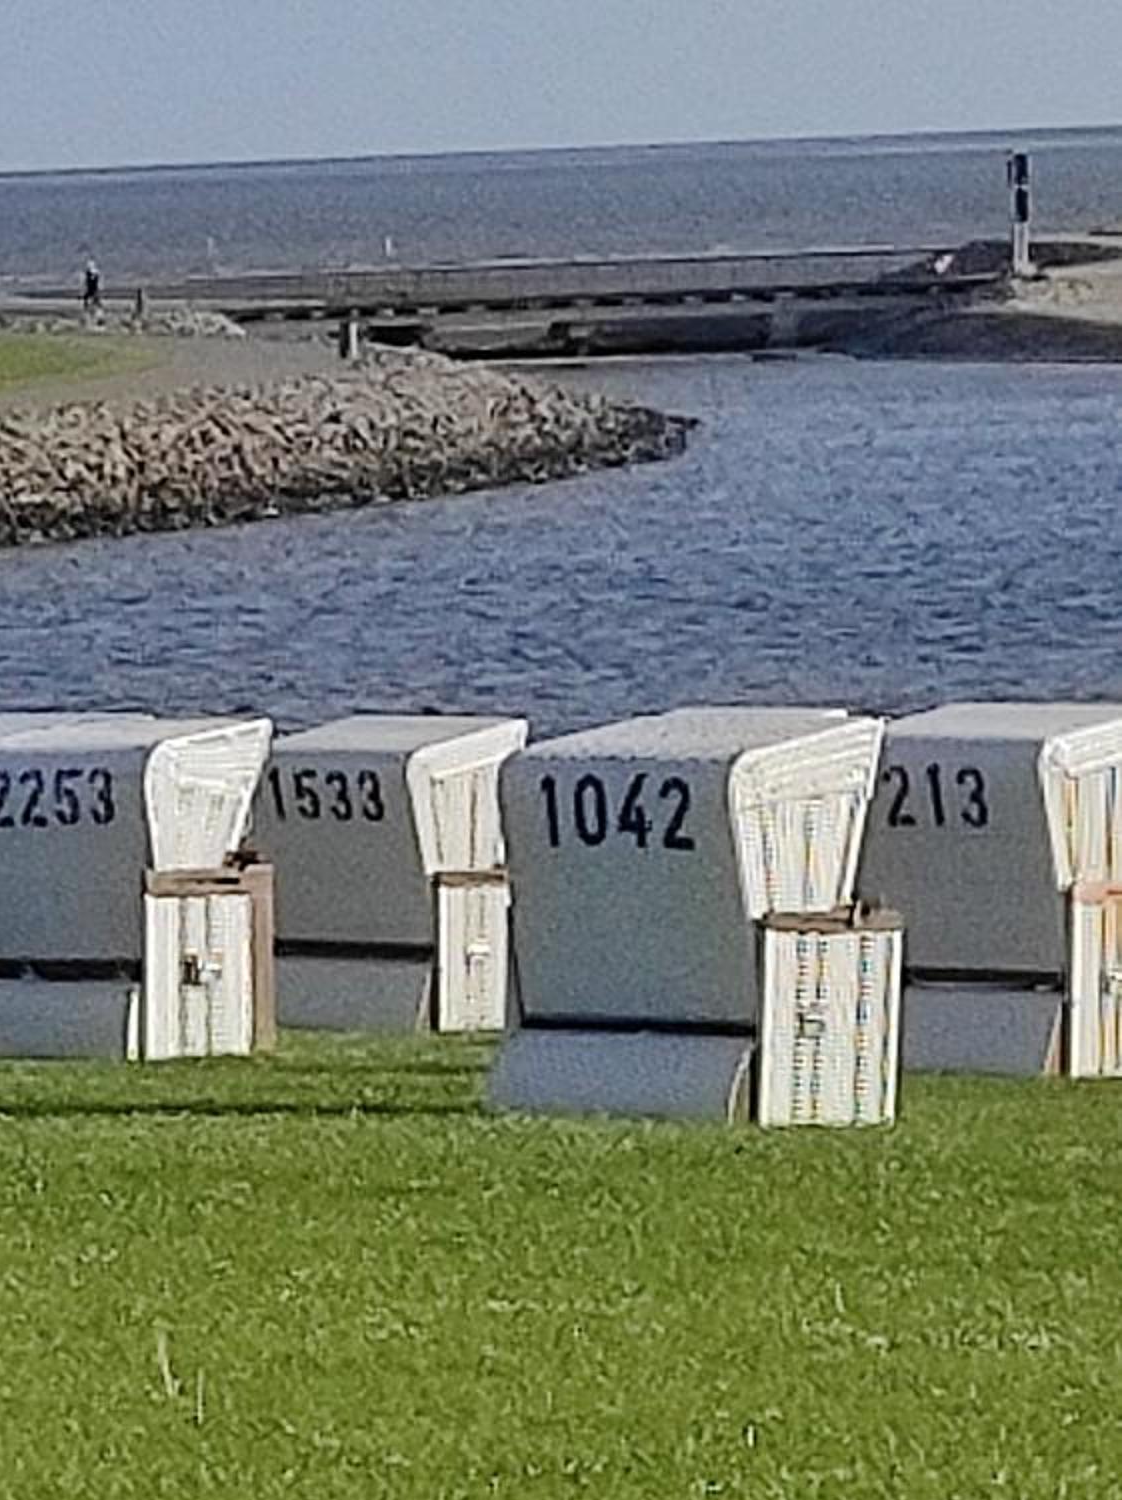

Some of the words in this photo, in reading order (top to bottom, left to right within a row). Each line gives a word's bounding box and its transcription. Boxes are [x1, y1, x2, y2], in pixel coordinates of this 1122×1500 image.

[269, 767, 386, 823] 1533
[539, 773, 697, 851] 1042
[882, 763, 989, 829] 213
